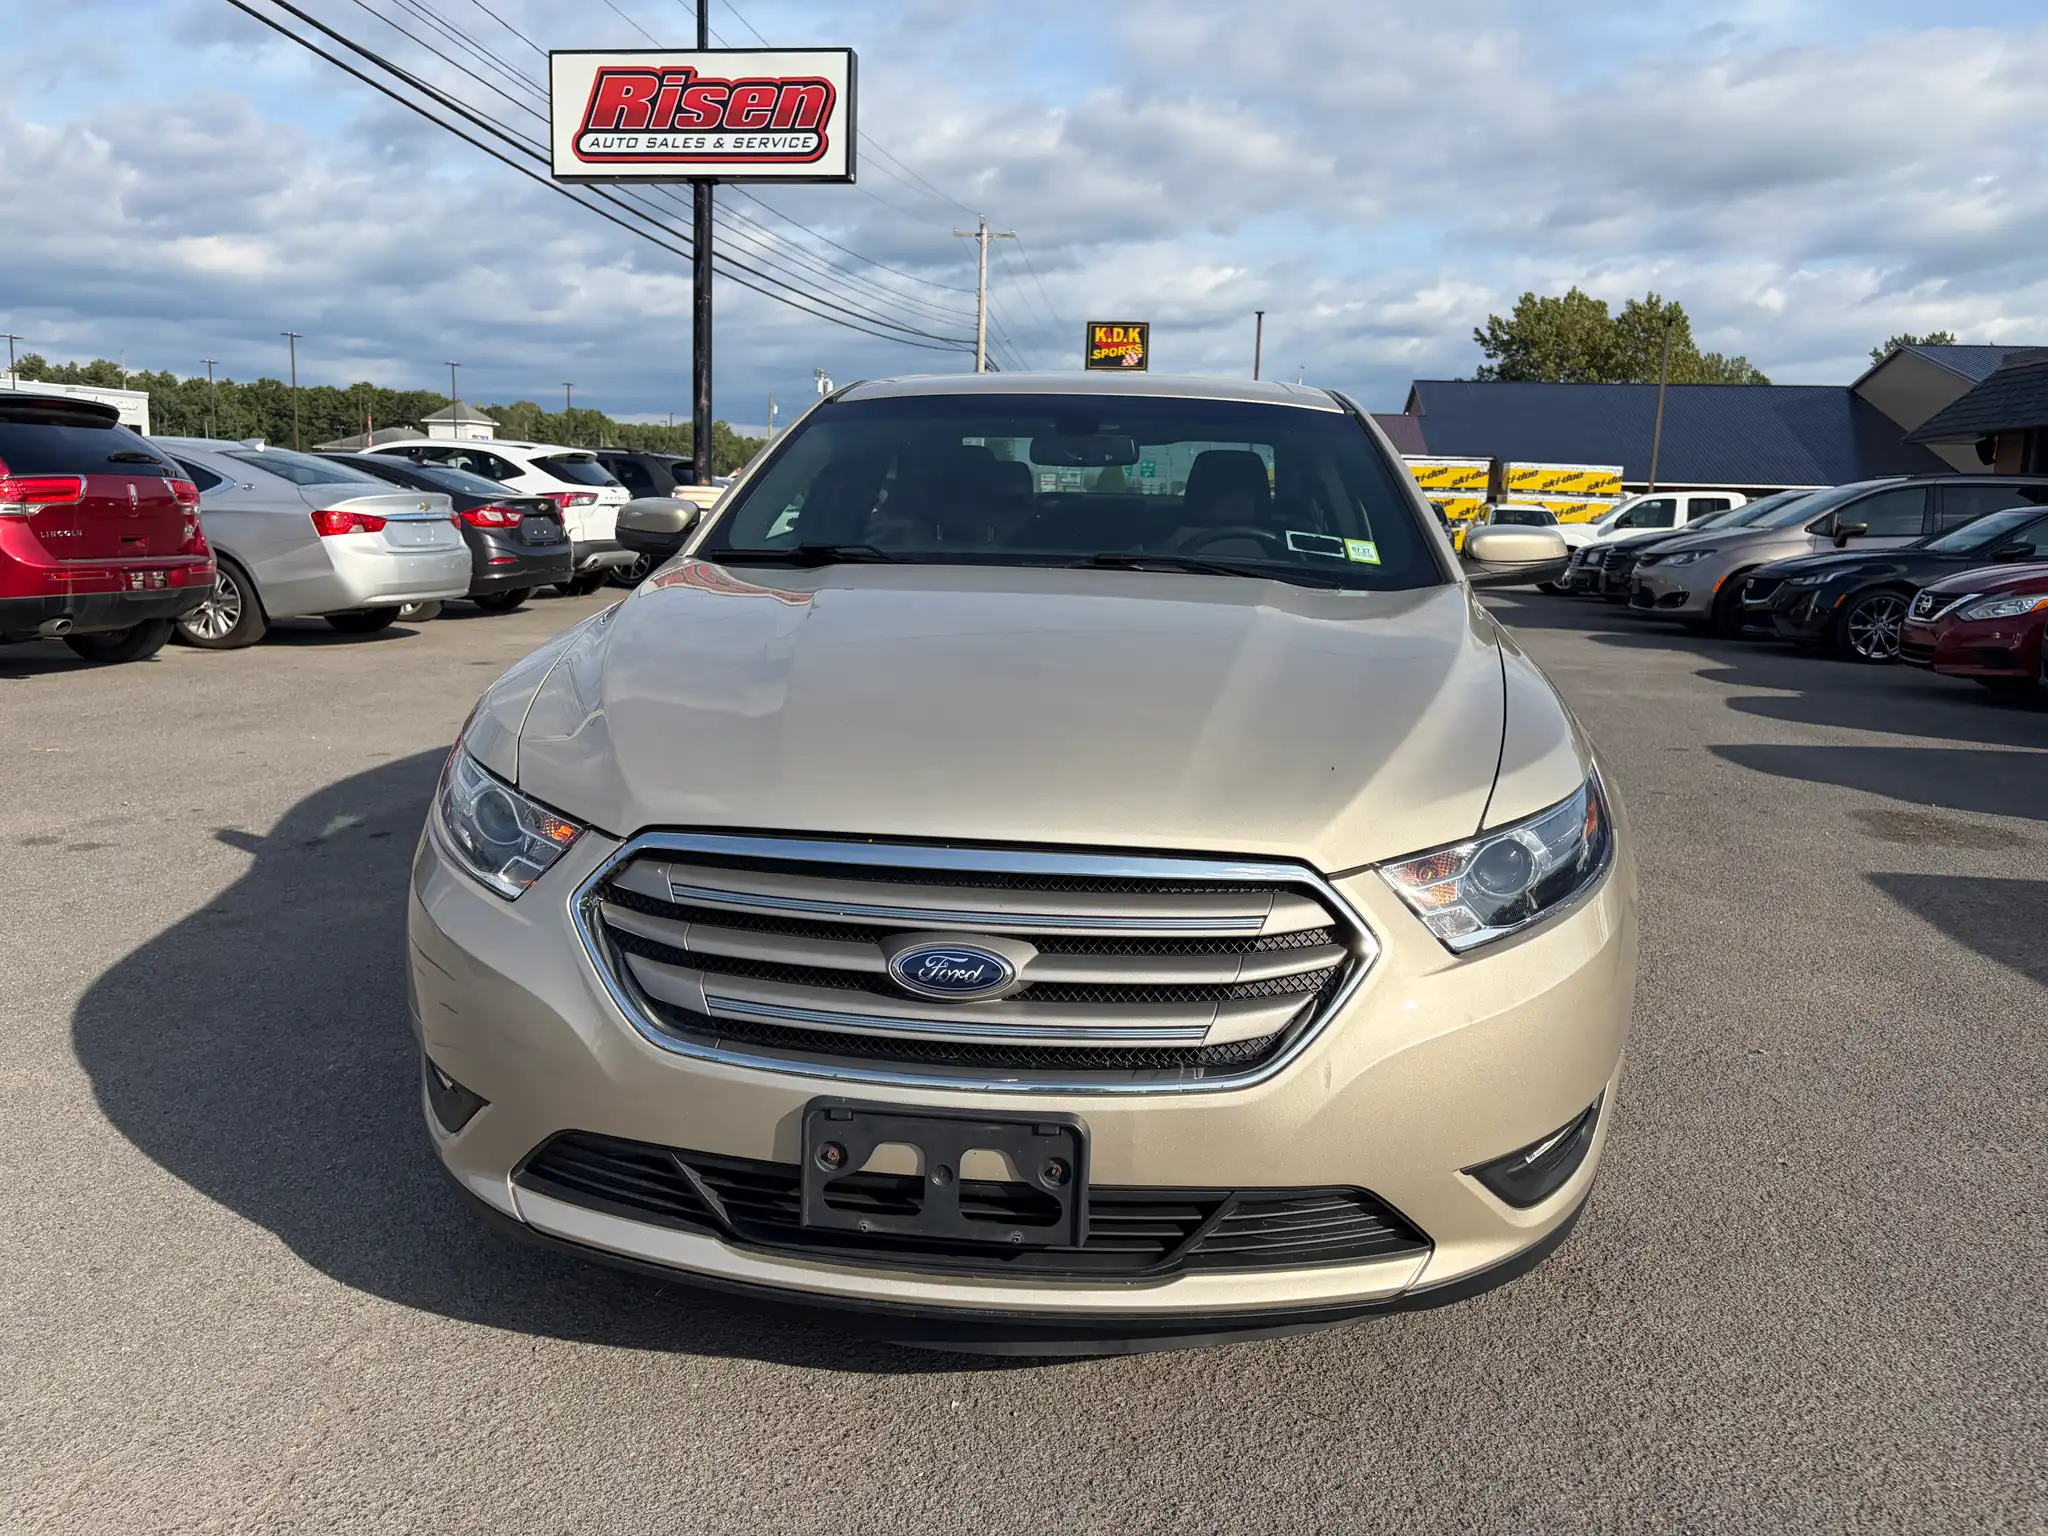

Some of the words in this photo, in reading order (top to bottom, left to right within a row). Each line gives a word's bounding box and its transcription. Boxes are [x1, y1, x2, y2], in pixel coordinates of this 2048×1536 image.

[588, 74, 826, 129] Risen
[589, 136, 639, 149] AUTO
[646, 136, 706, 149] SALES
[713, 136, 724, 149] &
[732, 136, 813, 149] SERVICE
[1095, 327, 1141, 343] K.D.K
[1093, 344, 1143, 359] SPORTS
[40, 530, 83, 538] LINCOLN
[917, 955, 985, 984] Ford
